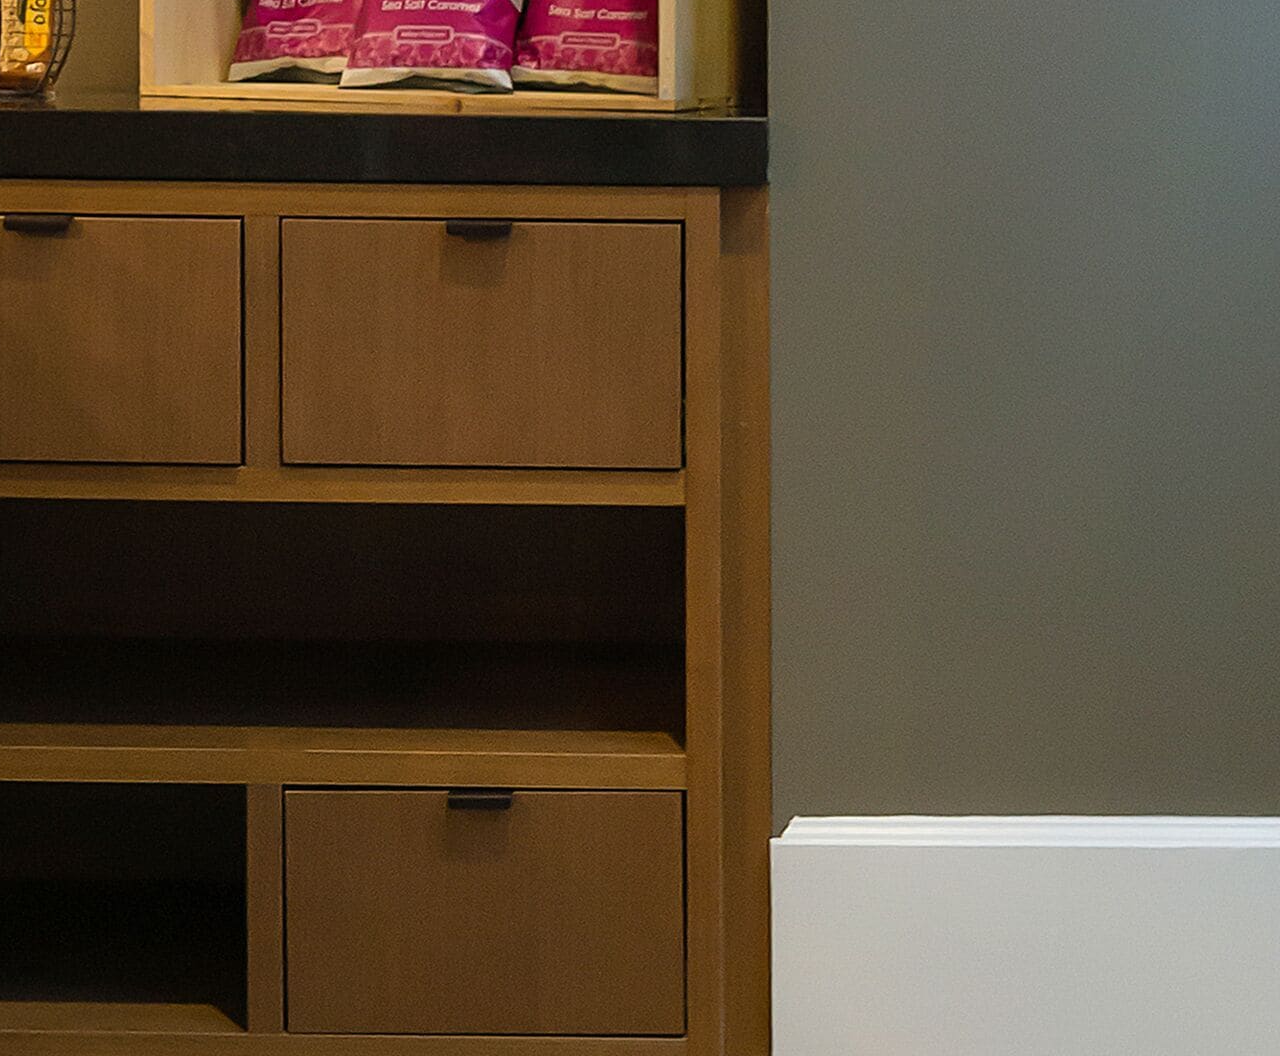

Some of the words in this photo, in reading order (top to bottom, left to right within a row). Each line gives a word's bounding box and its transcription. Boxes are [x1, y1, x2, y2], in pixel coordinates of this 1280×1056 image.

[381, 0, 402, 12] Sea
[427, 0, 482, 13] Caramel
[548, 4, 572, 17] Sea
[574, 7, 596, 19] Salt
[597, 7, 648, 21] Caramel
